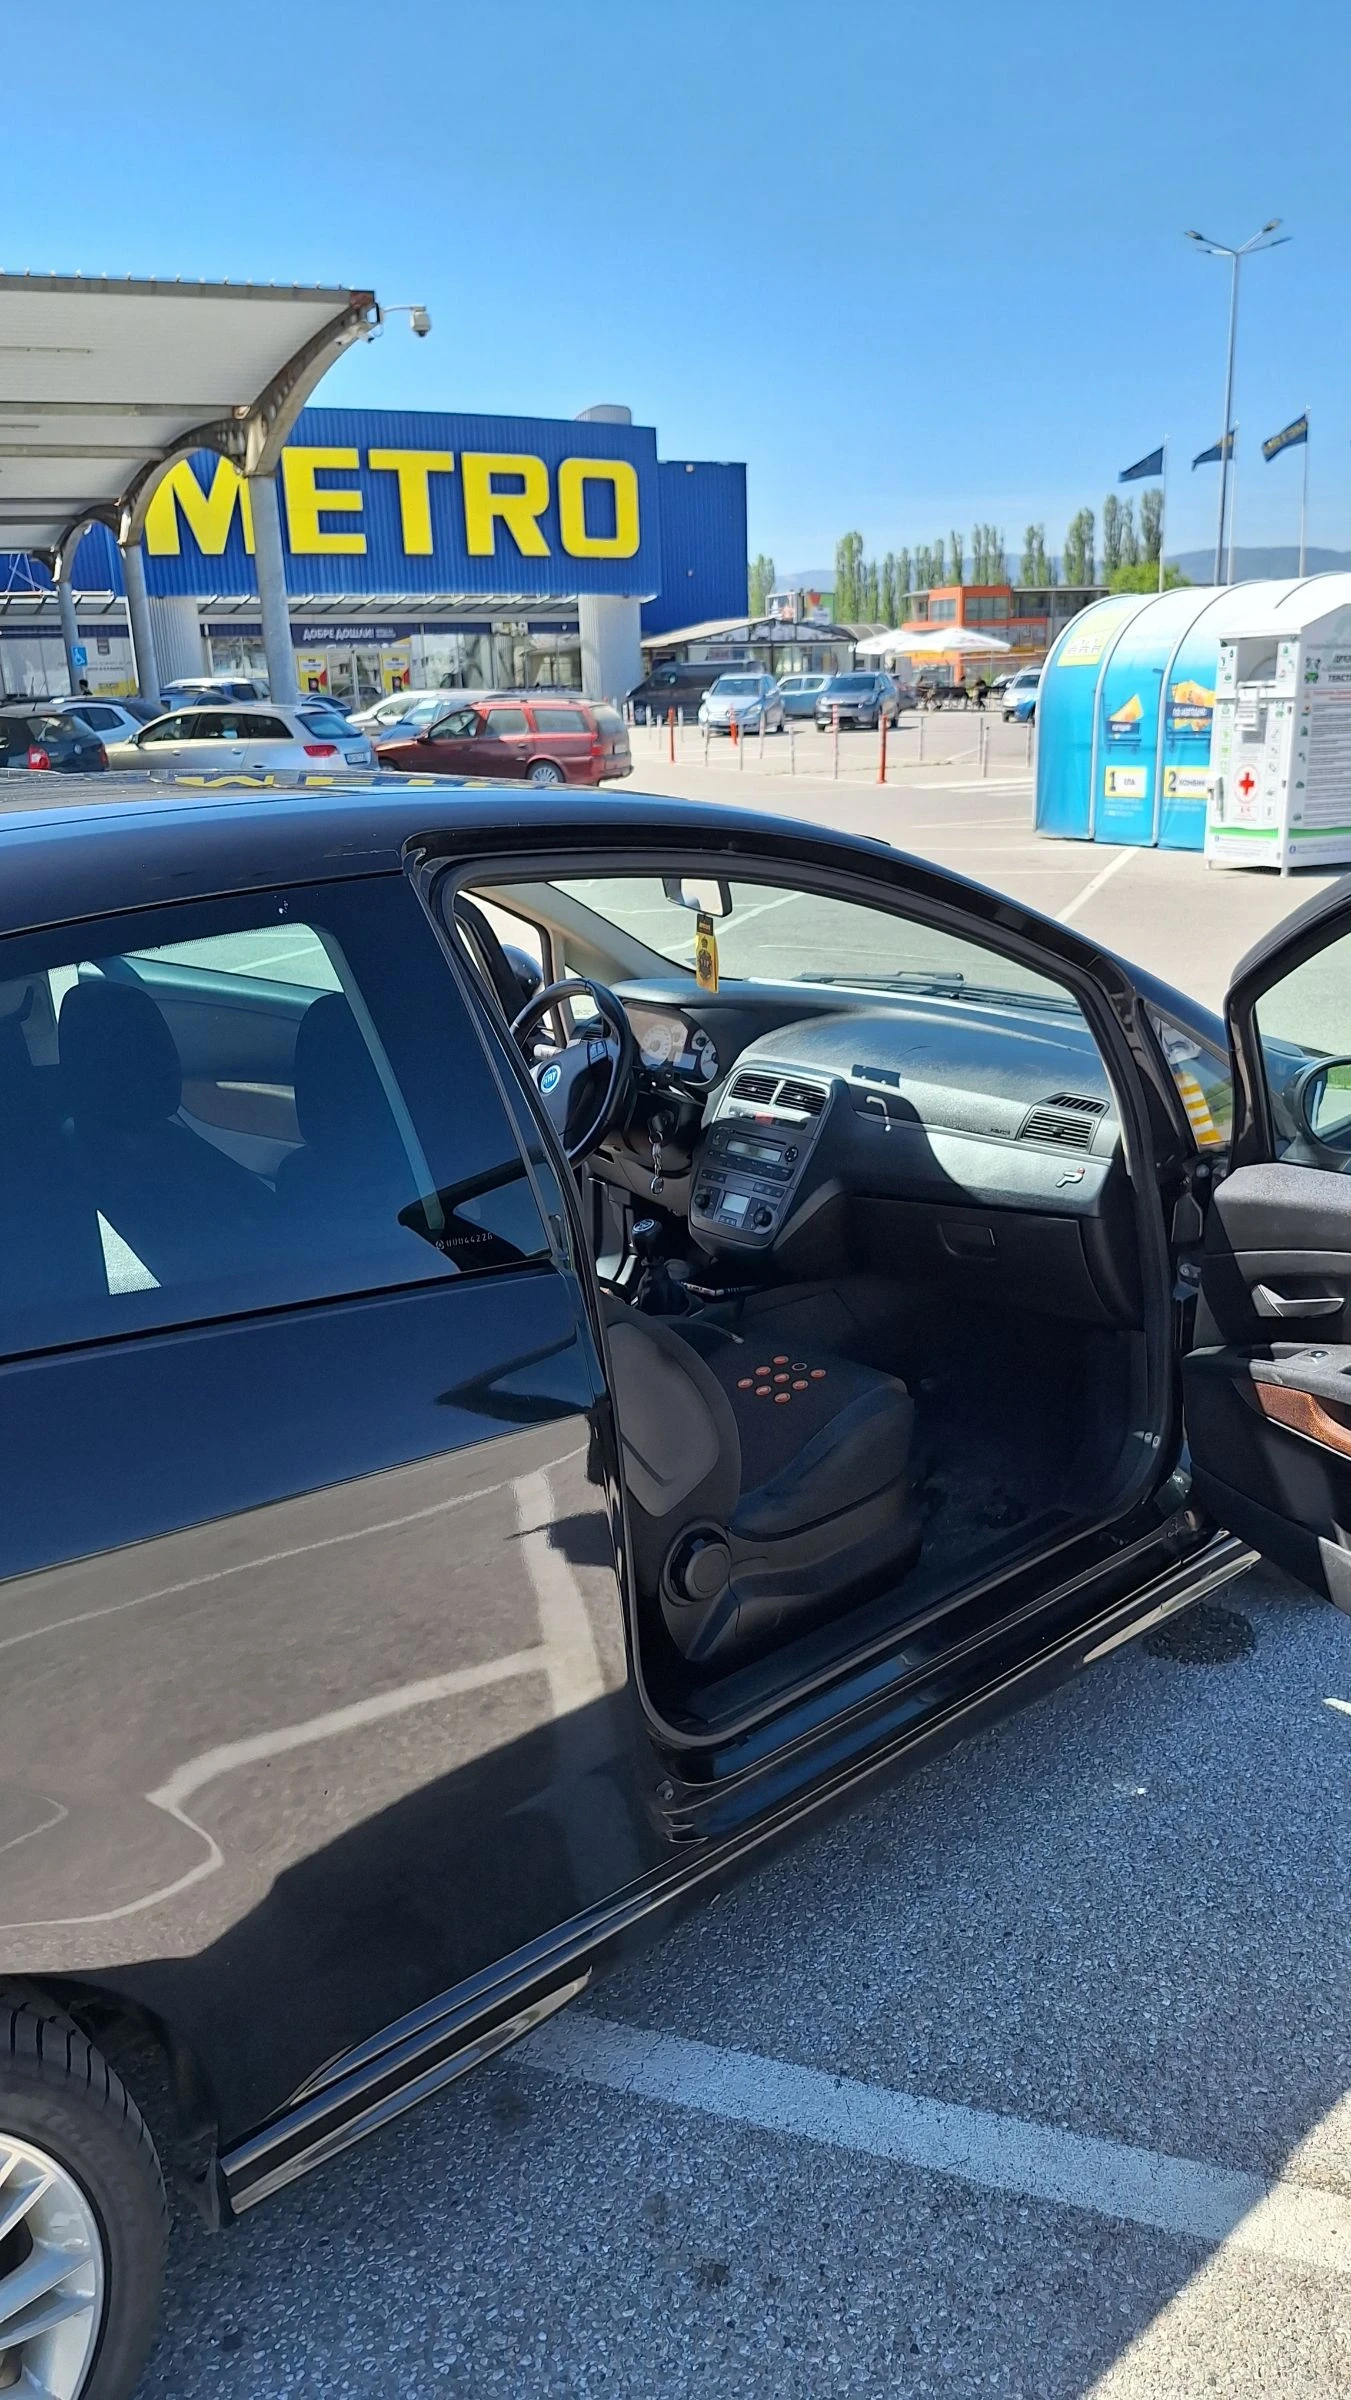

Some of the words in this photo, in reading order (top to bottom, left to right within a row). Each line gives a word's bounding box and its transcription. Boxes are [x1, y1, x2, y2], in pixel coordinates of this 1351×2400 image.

[145, 446, 640, 560] METRO
[303, 628, 334, 641] ДОБРЕ
[335, 628, 374, 641] ДОШЛИ!
[1109, 770, 1117, 792] 1
[1168, 771, 1177, 792] 2
